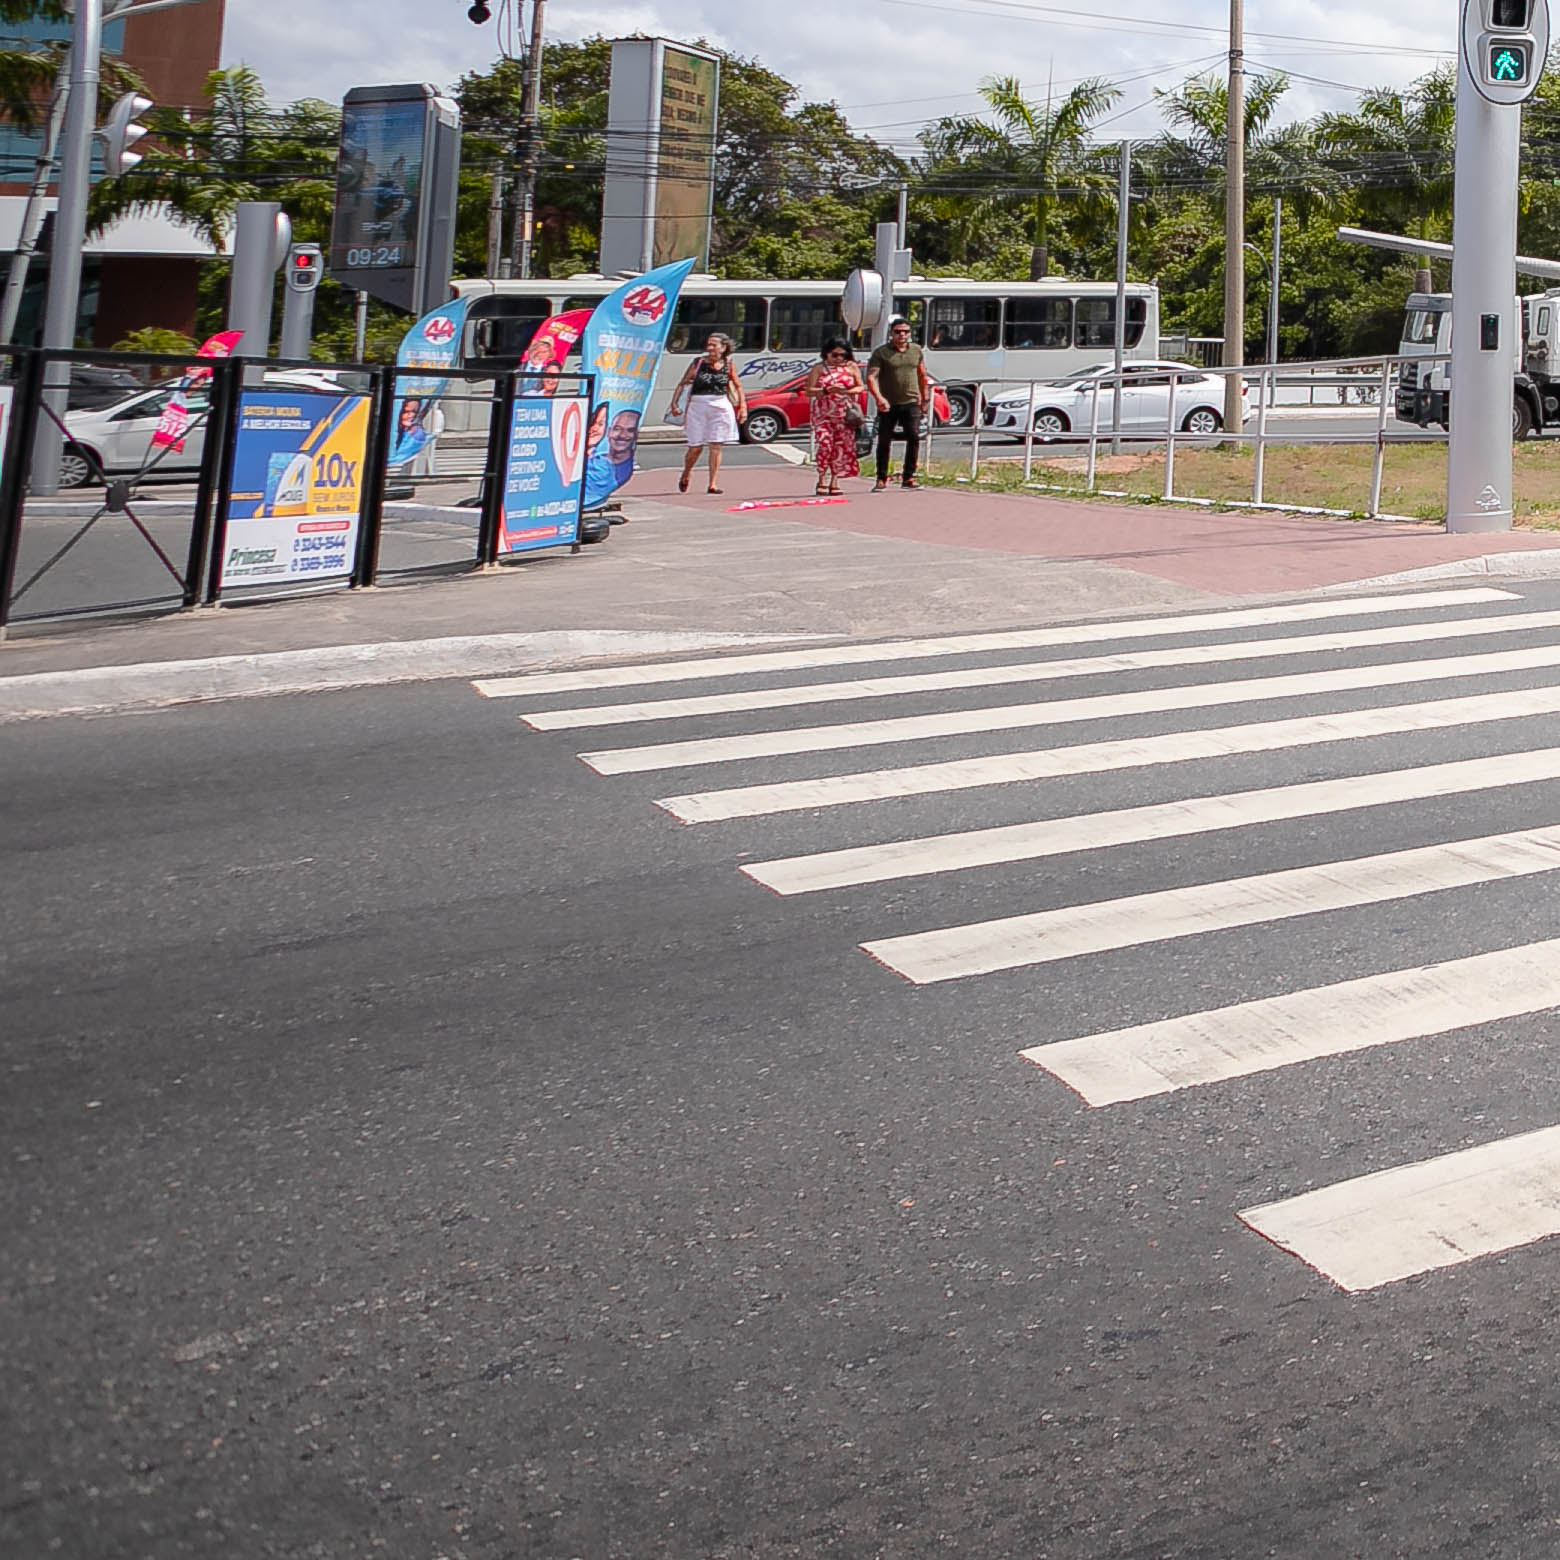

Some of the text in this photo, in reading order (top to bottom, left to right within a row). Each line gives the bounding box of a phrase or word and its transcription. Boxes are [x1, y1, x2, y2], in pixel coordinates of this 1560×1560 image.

[346, 246, 401, 266] 09:24
[423, 319, 455, 340] 44
[314, 453, 357, 488] 10x
